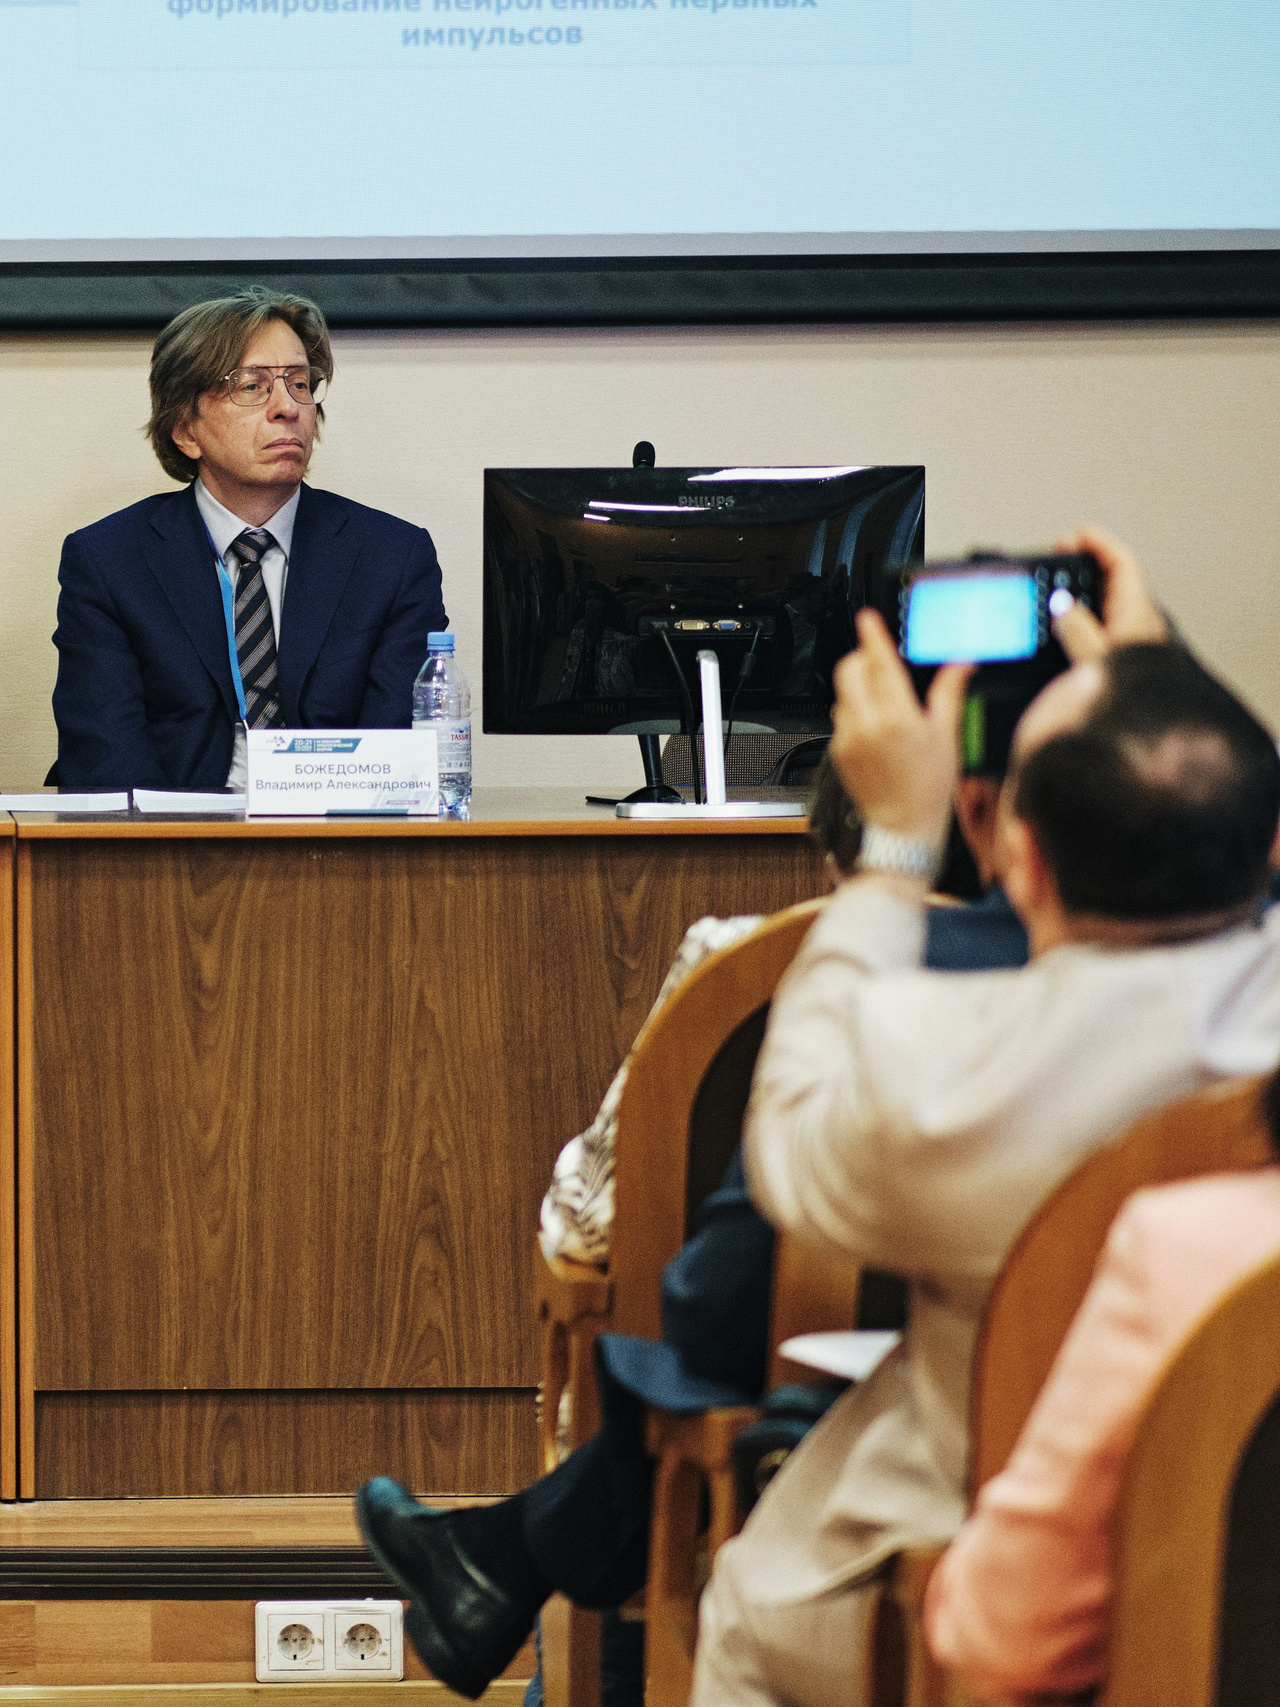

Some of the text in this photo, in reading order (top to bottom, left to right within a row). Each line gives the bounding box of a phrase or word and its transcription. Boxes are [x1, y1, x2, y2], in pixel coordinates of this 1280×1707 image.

[166, 0, 421, 19] формирование
[401, 25, 583, 51] импульсов
[678, 495, 736, 508] PHILIPS
[294, 763, 392, 776] БОЖЕДОМОВ
[255, 779, 432, 792] Владимир Александрович
